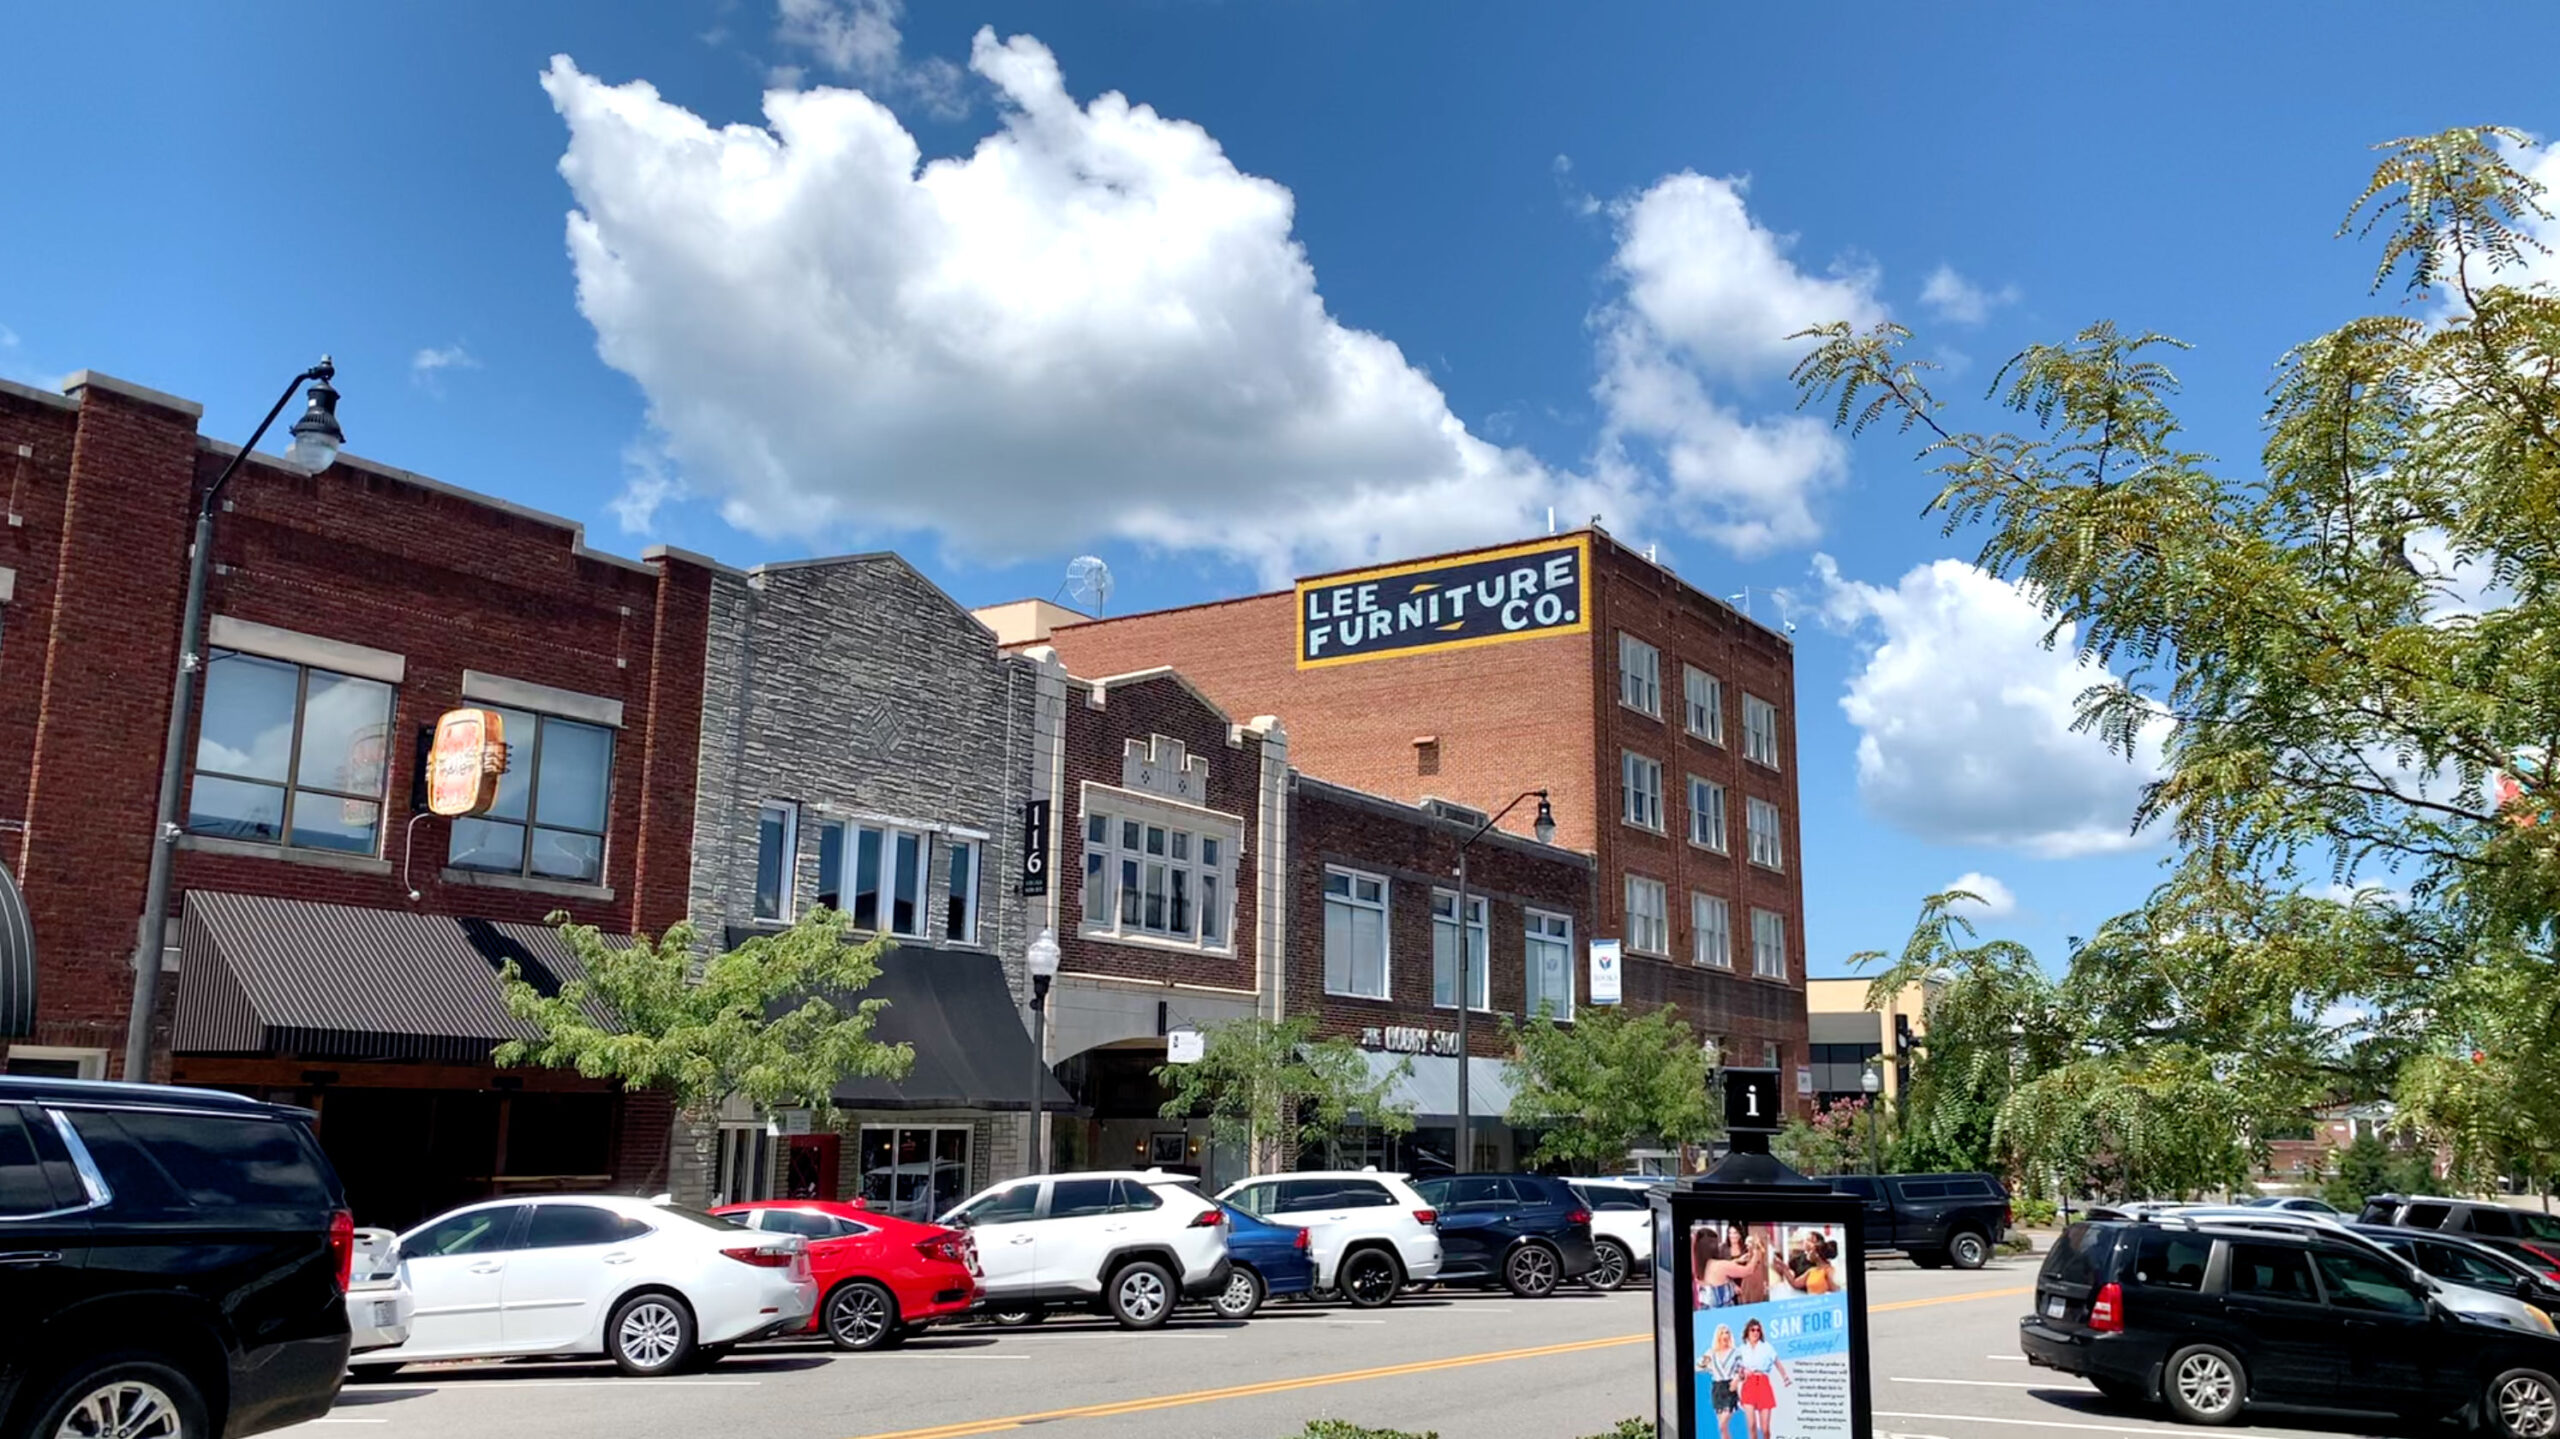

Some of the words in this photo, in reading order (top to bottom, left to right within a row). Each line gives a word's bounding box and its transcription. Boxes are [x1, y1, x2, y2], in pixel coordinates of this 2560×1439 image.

[1309, 583, 1379, 621] LEE
[1309, 555, 1575, 656] FURNITURE
[1501, 593, 1576, 630] CO.
[1431, 1030, 1460, 1055] SHO
[1769, 1309, 1843, 1340] SANFORD
